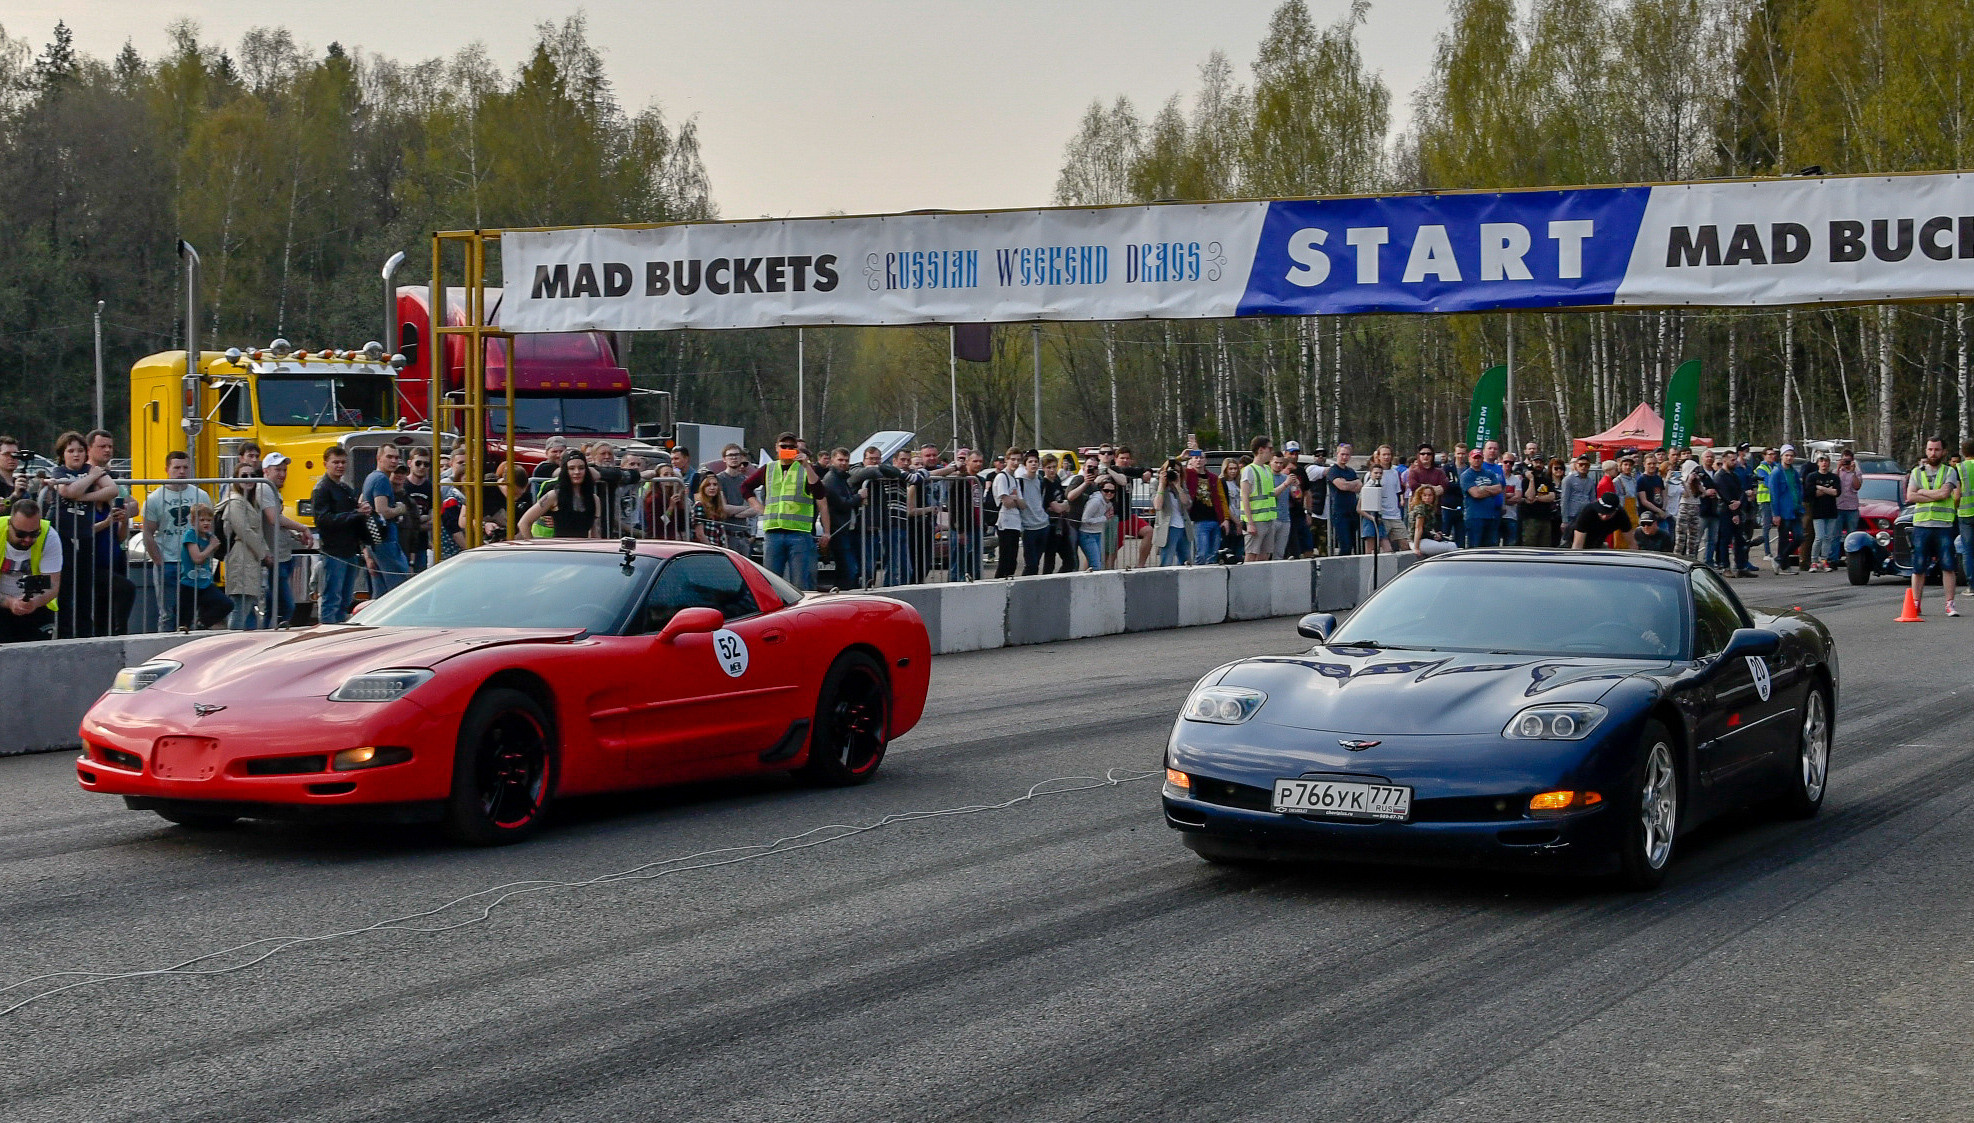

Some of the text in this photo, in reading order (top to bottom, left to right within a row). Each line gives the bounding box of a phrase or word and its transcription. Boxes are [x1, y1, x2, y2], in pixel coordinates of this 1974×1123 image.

[886, 241, 1201, 290] RUSSIAN WEEKEND DRAGS
[1285, 219, 1594, 287] START
[1666, 222, 1811, 267] MAD
[531, 254, 839, 299] MAD BUCKETS
[1475, 406, 1488, 449] EEDOM
[1670, 402, 1682, 446] EEDOM
[717, 636, 741, 660] 52
[1749, 656, 1766, 682] 20
[1370, 786, 1405, 806] 777
[1375, 804, 1393, 813] RUS
